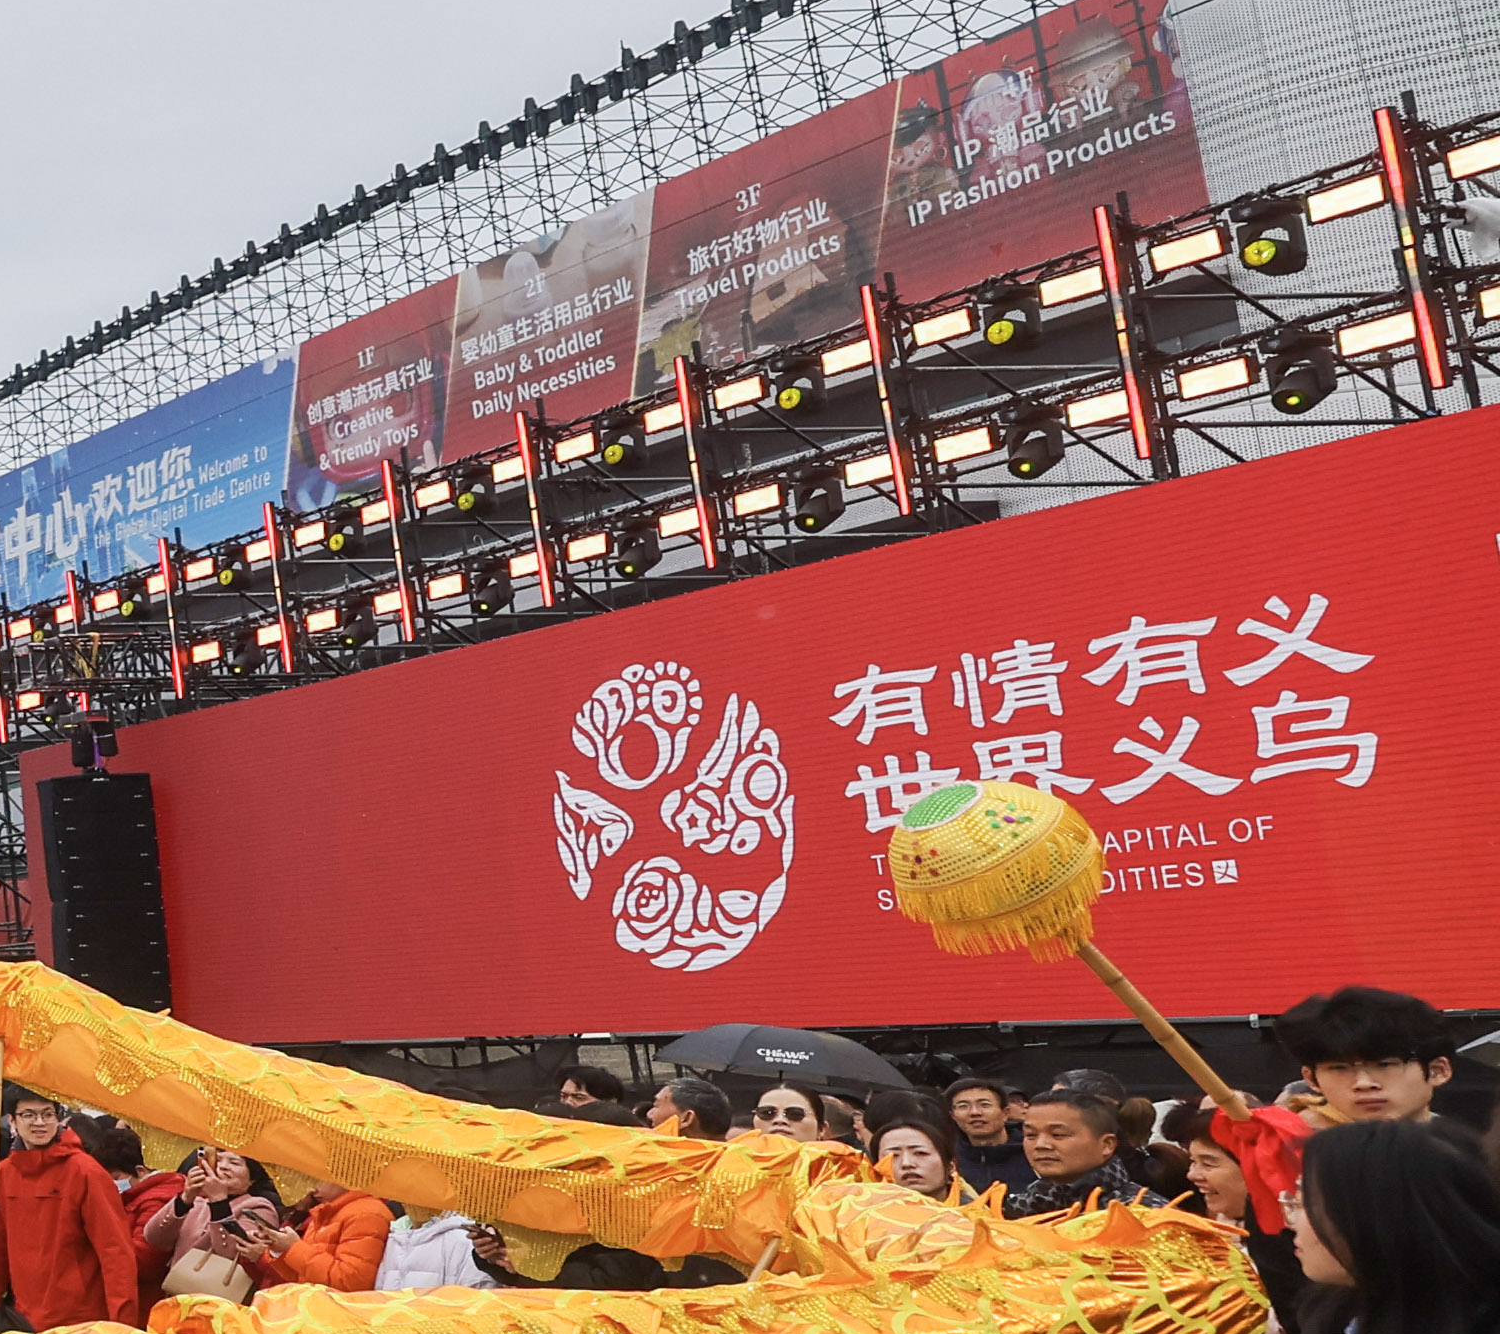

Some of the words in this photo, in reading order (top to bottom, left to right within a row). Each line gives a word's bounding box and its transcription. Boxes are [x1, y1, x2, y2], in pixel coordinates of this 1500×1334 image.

[1000, 66, 1034, 100] 4F
[952, 137, 981, 170] IP
[988, 85, 1114, 158] 潮品行业
[734, 182, 762, 213] 3F
[907, 198, 933, 228] IP
[938, 161, 1041, 216] Fashion
[1045, 110, 1177, 175] Products
[686, 197, 831, 276] 旅行好物行业
[523, 271, 547, 299] 2F
[674, 267, 740, 310] Travel
[741, 233, 841, 286] Products
[460, 275, 635, 366] 婴幼童生活用品行业
[306, 356, 435, 426] 创意潮流玩具行业
[356, 345, 376, 369] 1F
[471, 388, 514, 420] Daily
[516, 354, 617, 404] Necessities
[473, 361, 515, 391] Baby
[518, 352, 534, 374] &
[534, 326, 604, 367] Toddler
[319, 452, 332, 472] &
[331, 435, 382, 466] Trendy
[383, 422, 419, 448] Toys
[333, 404, 394, 439] Creative
[91, 444, 196, 531] 欢迎您
[198, 452, 249, 485] Welcome
[254, 445, 269, 464] to
[114, 511, 149, 542] Global
[150, 497, 189, 529] Digital
[191, 487, 226, 513] Trade
[229, 471, 271, 500] Centre
[828, 593, 1376, 745] 有情有义
[844, 689, 1379, 834] 世界义乌
[1102, 821, 1217, 855] APITAL
[1228, 815, 1274, 842] OF
